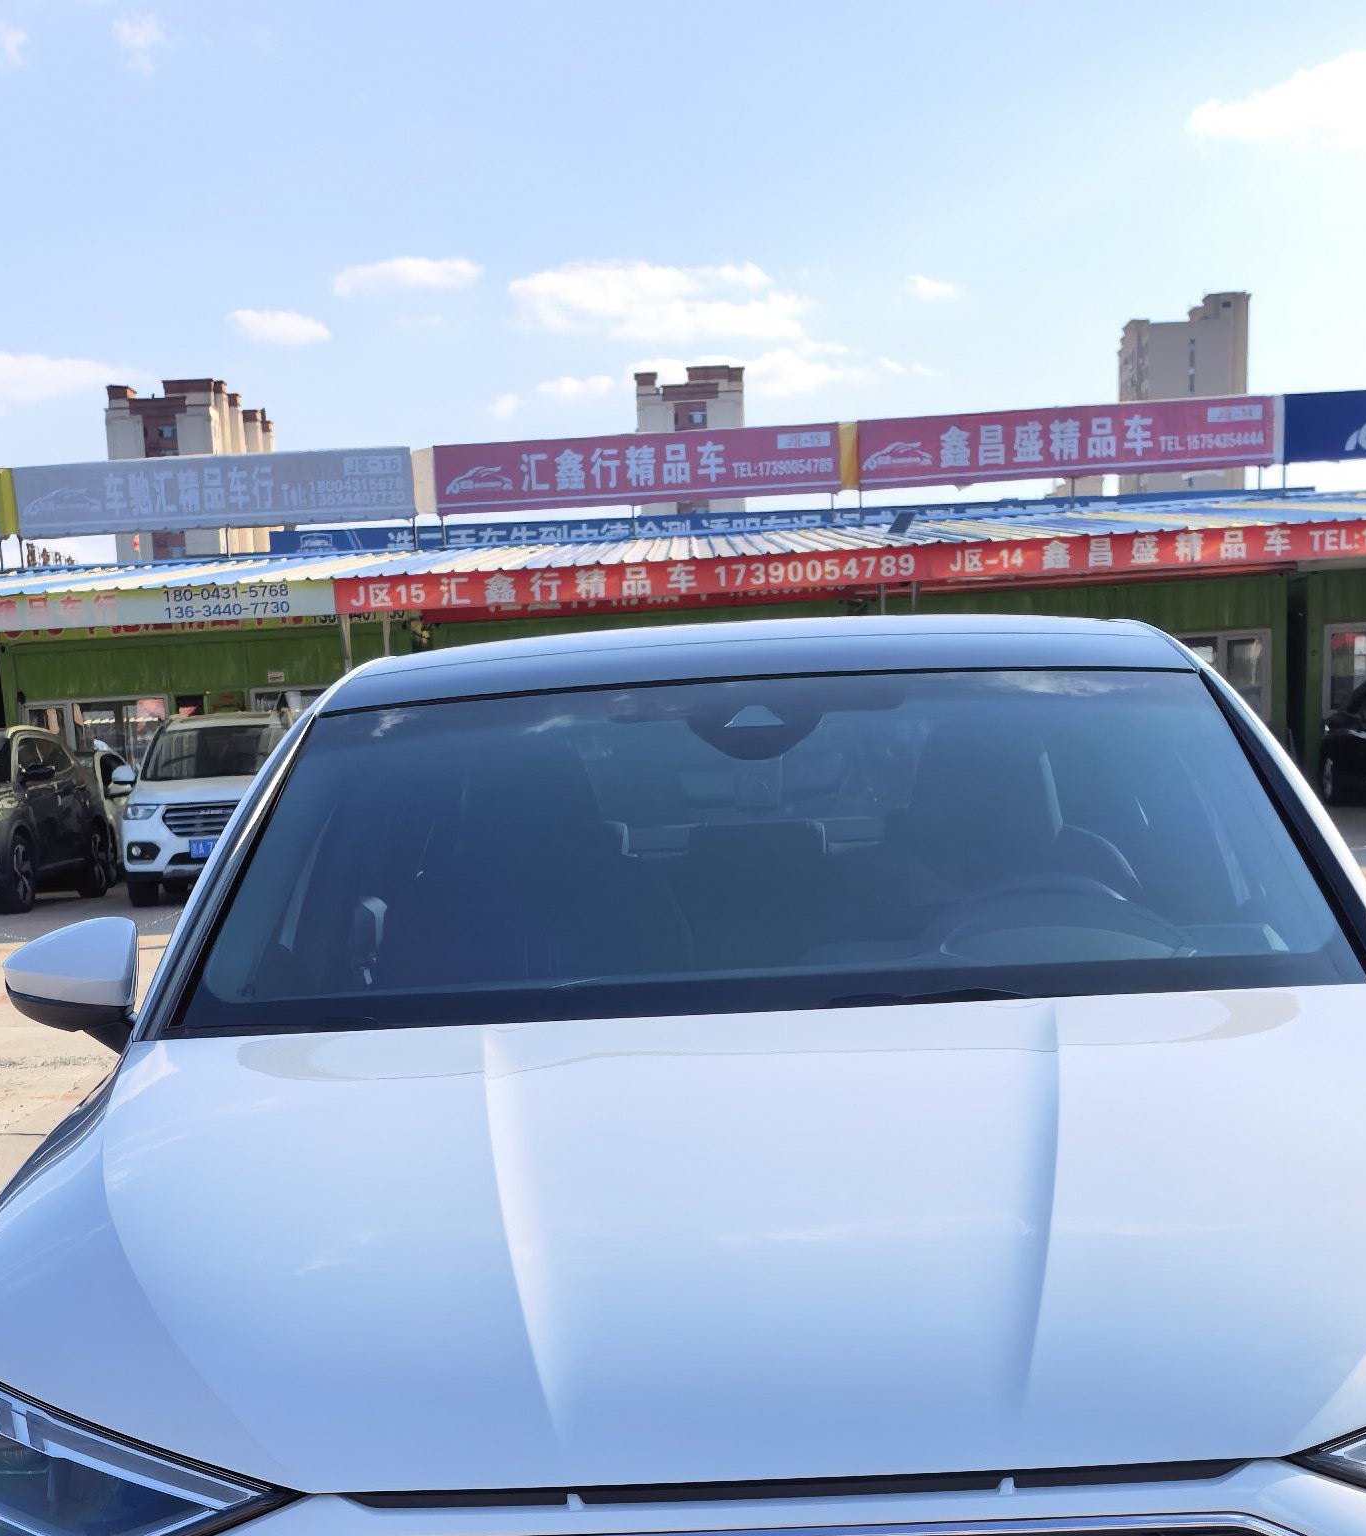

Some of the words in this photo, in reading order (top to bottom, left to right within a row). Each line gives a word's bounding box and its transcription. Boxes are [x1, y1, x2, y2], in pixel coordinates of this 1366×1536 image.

[939, 414, 1153, 467] 鑫昌盛精品车
[521, 440, 726, 492] 汇鑫行精品车
[949, 548, 1024, 573] J区-14
[1042, 529, 1292, 570] 鑫昌盛精品车
[163, 583, 289, 603] 180-0431-5768
[350, 583, 427, 607] J区15
[441, 564, 698, 607] 汇鑫行精品车
[714, 554, 915, 587] 17390054789
[165, 601, 290, 620] 136-3440-7730
